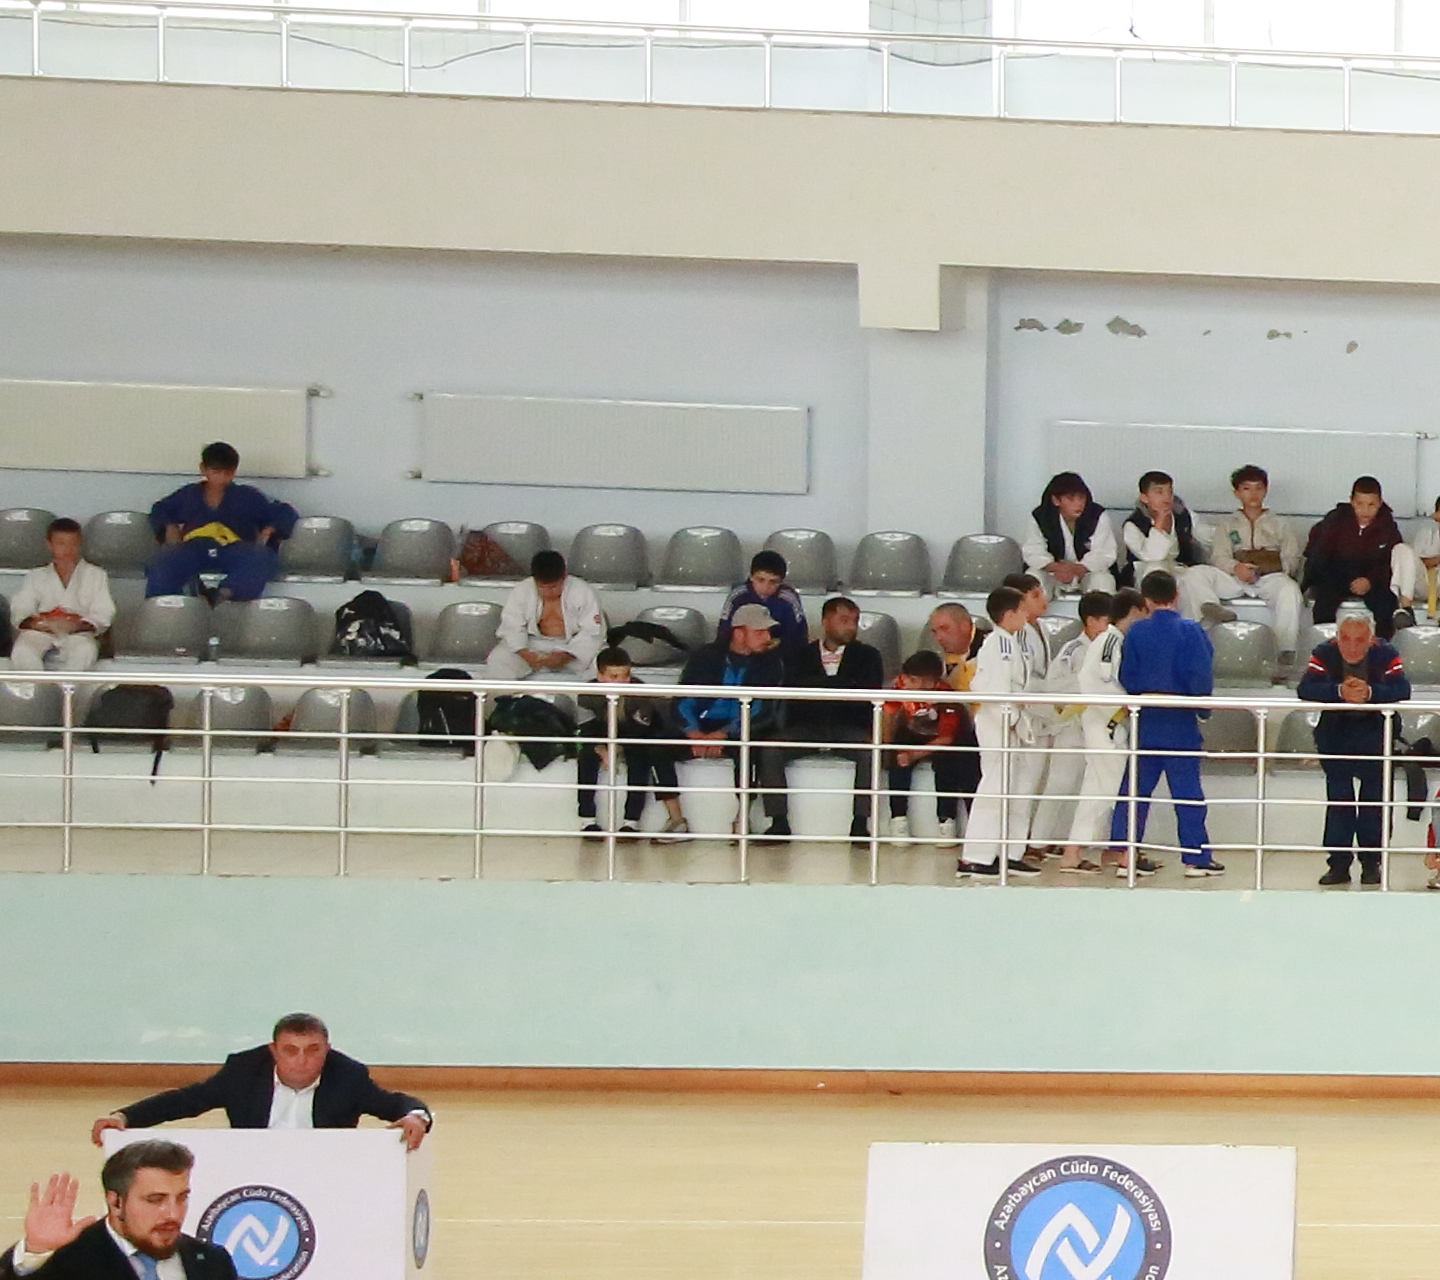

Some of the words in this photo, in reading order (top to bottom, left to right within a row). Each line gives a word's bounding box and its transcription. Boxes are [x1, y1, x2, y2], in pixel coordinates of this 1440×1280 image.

[994, 1168, 1057, 1231] Azərbaycan
[1060, 1161, 1099, 1175] Cüdo
[1101, 1164, 1162, 1232] Federasiyası
